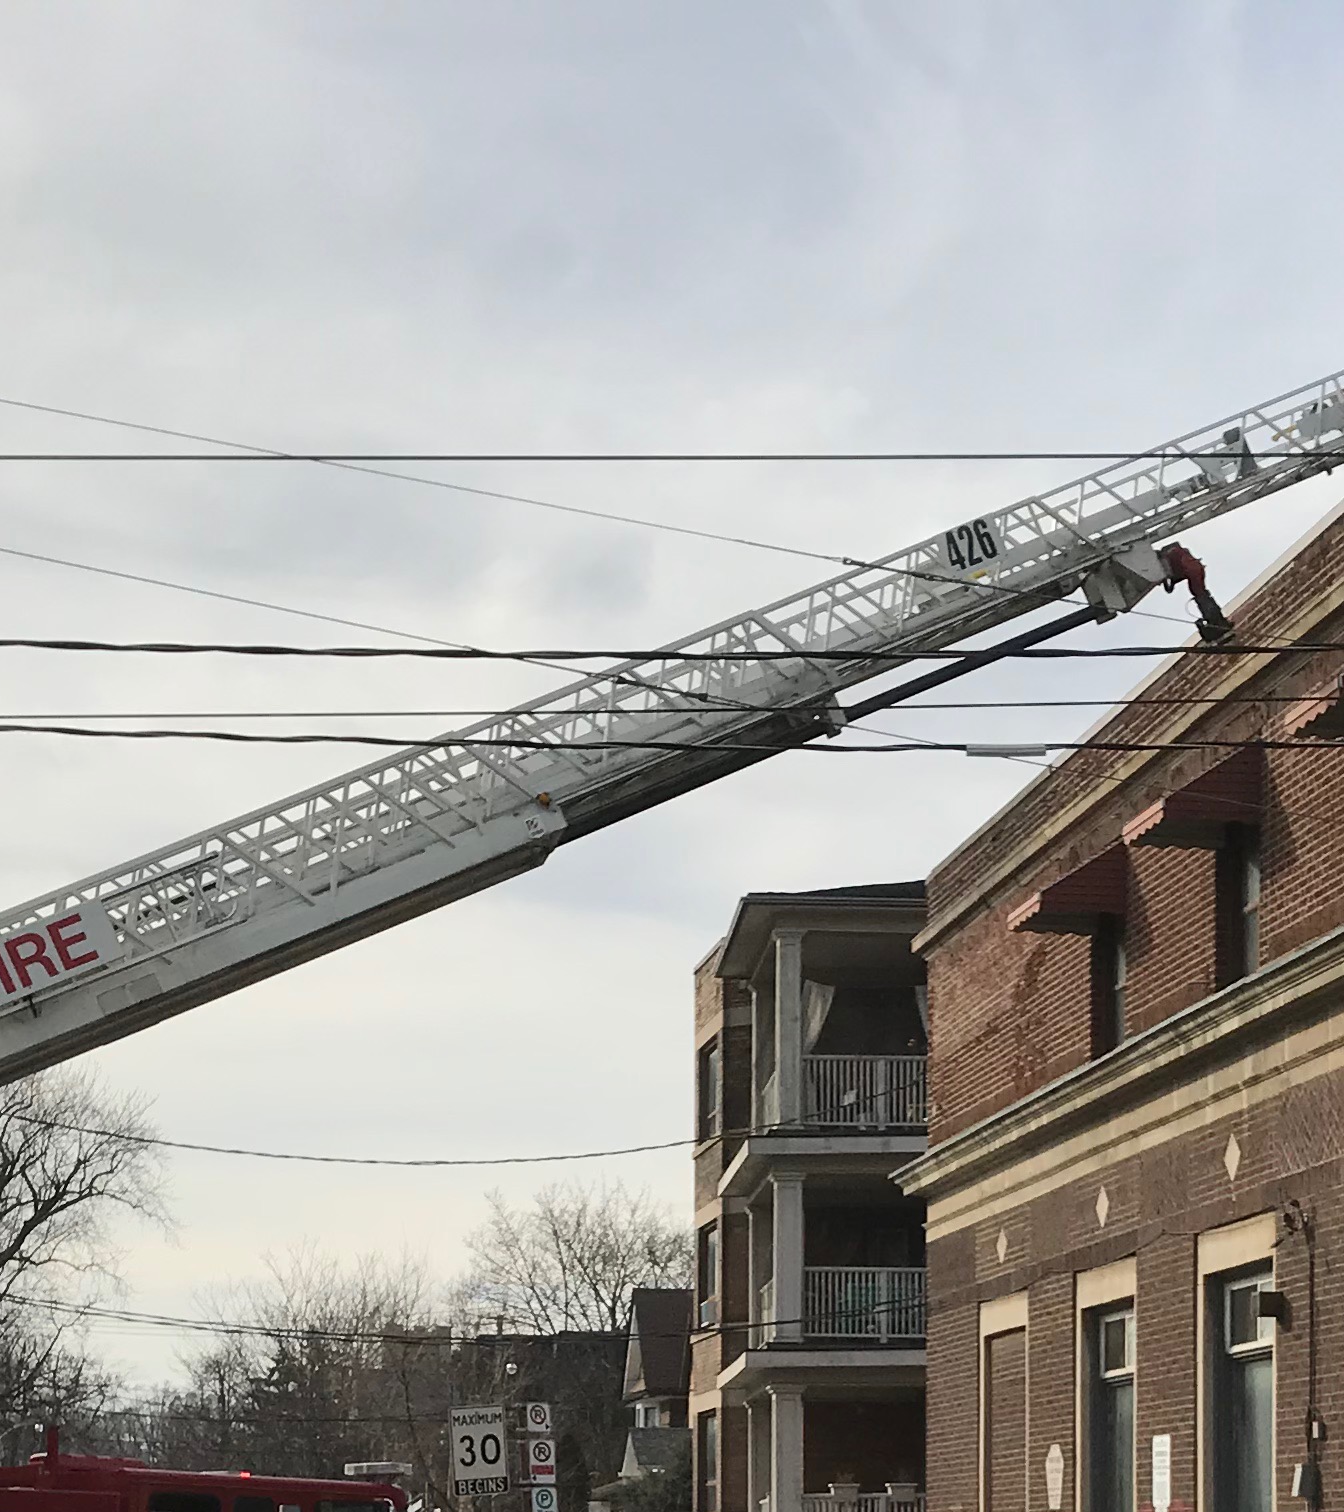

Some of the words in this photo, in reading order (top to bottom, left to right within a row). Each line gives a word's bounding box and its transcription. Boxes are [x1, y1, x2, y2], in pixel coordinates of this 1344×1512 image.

[945, 519, 998, 570] 426
[452, 1411, 503, 1427] MAXIMUM
[459, 1433, 501, 1467] 30
[457, 1478, 505, 1495] BEGINS
